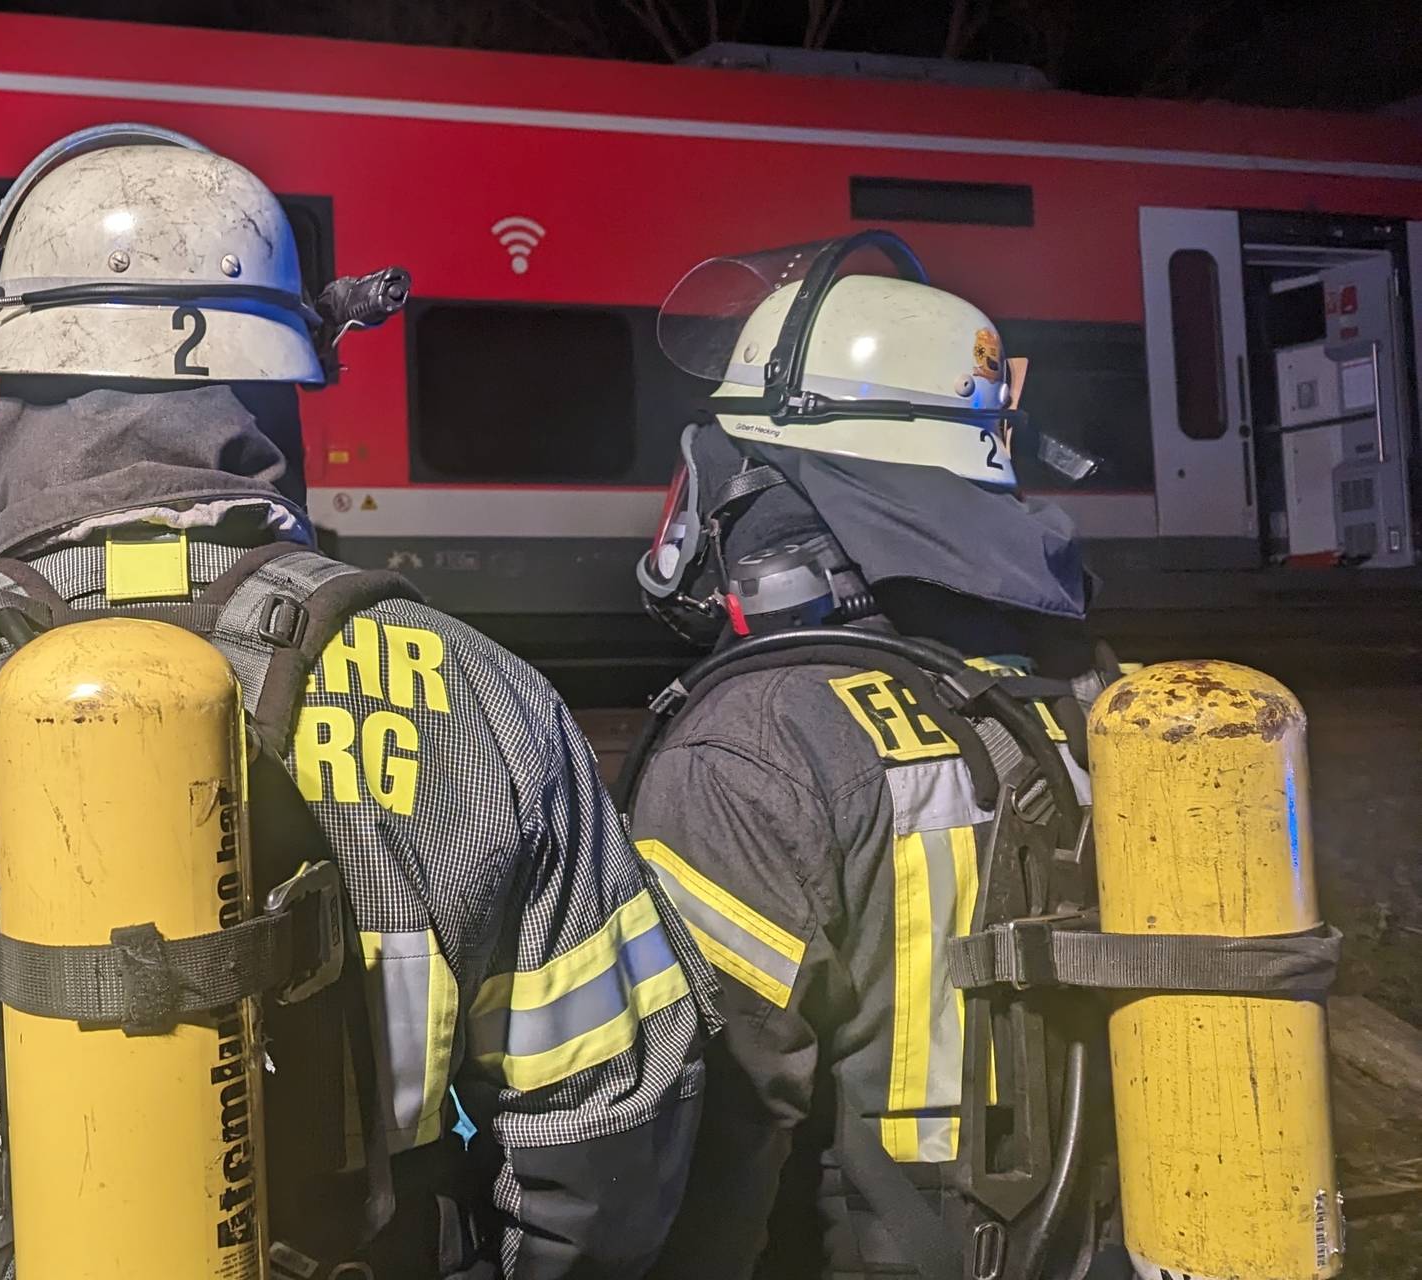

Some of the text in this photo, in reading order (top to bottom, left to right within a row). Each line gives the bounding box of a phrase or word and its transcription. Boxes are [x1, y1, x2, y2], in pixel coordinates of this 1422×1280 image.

[172, 305, 209, 376] 2
[980, 429, 1003, 470] 2
[847, 681, 947, 751] FE
